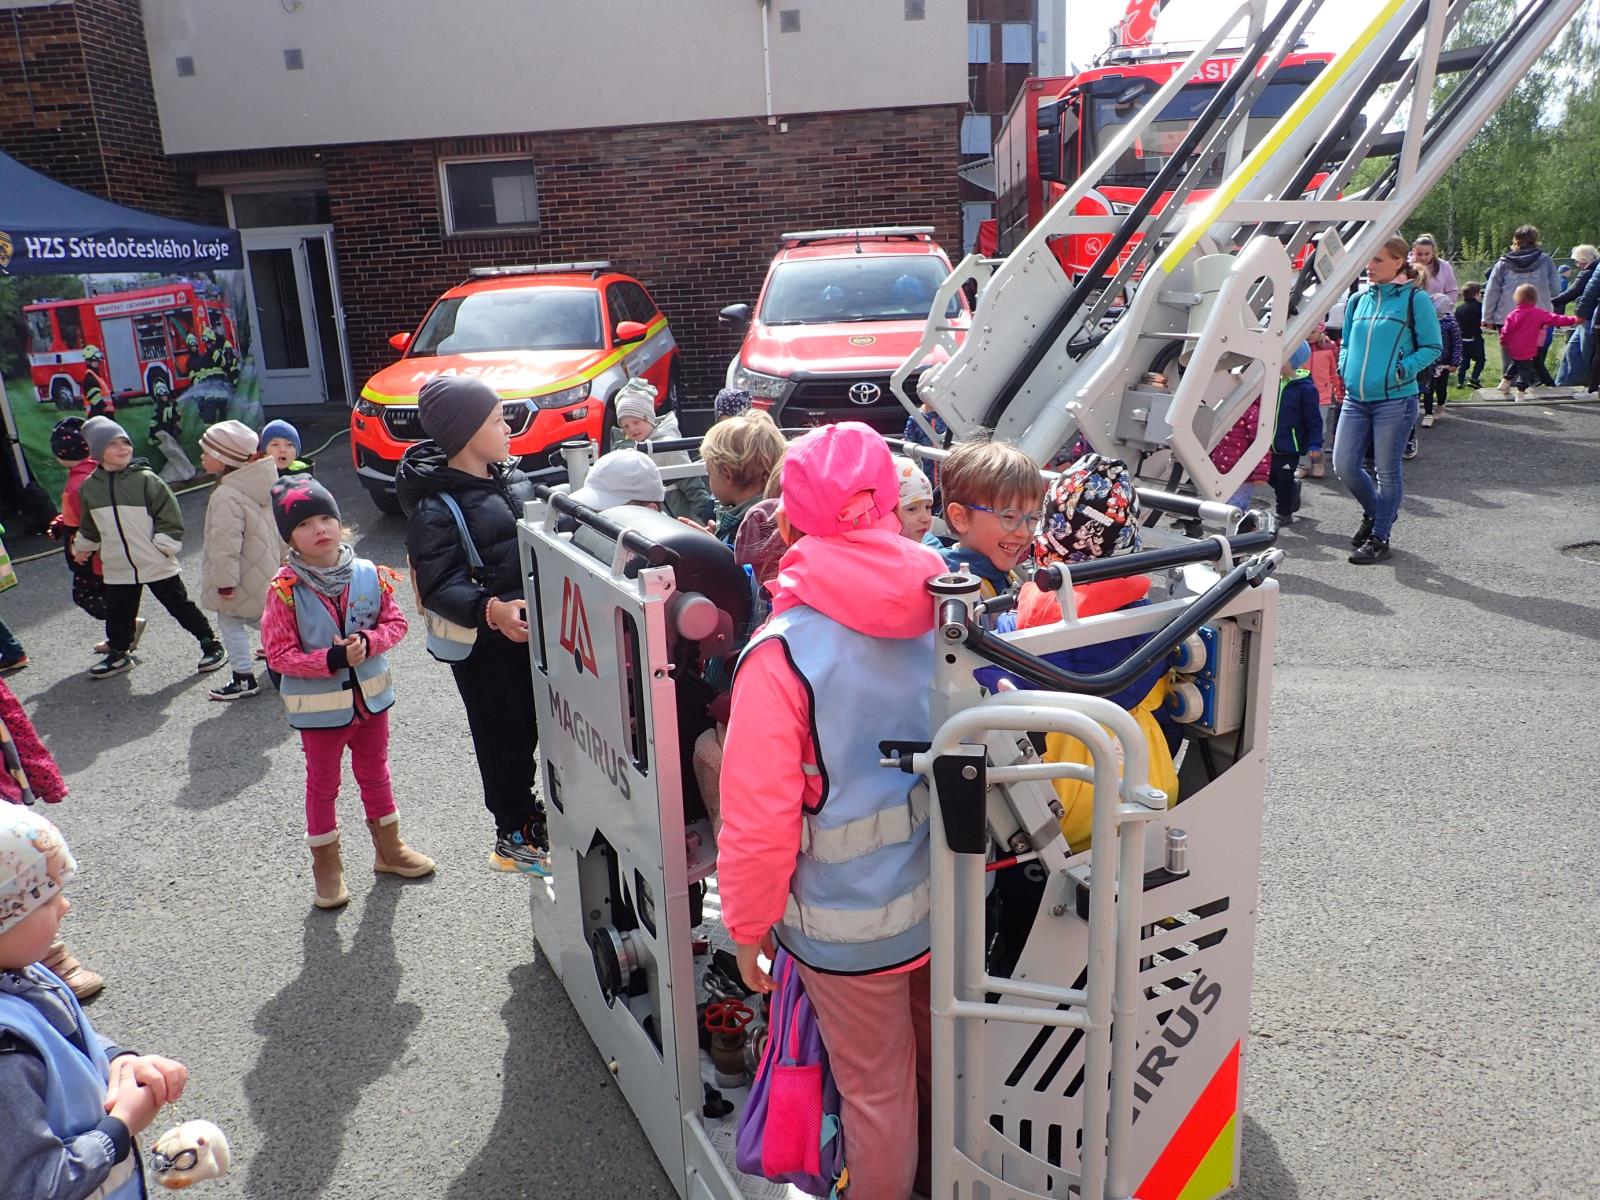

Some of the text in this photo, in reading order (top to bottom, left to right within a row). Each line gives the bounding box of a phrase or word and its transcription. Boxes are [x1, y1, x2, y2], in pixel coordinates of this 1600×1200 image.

[1171, 59, 1242, 82] ASI
[24, 236, 229, 260] HZS Středočeského kraje
[548, 682, 632, 801] MAGIRUS
[1132, 973, 1222, 1127] IRUS
